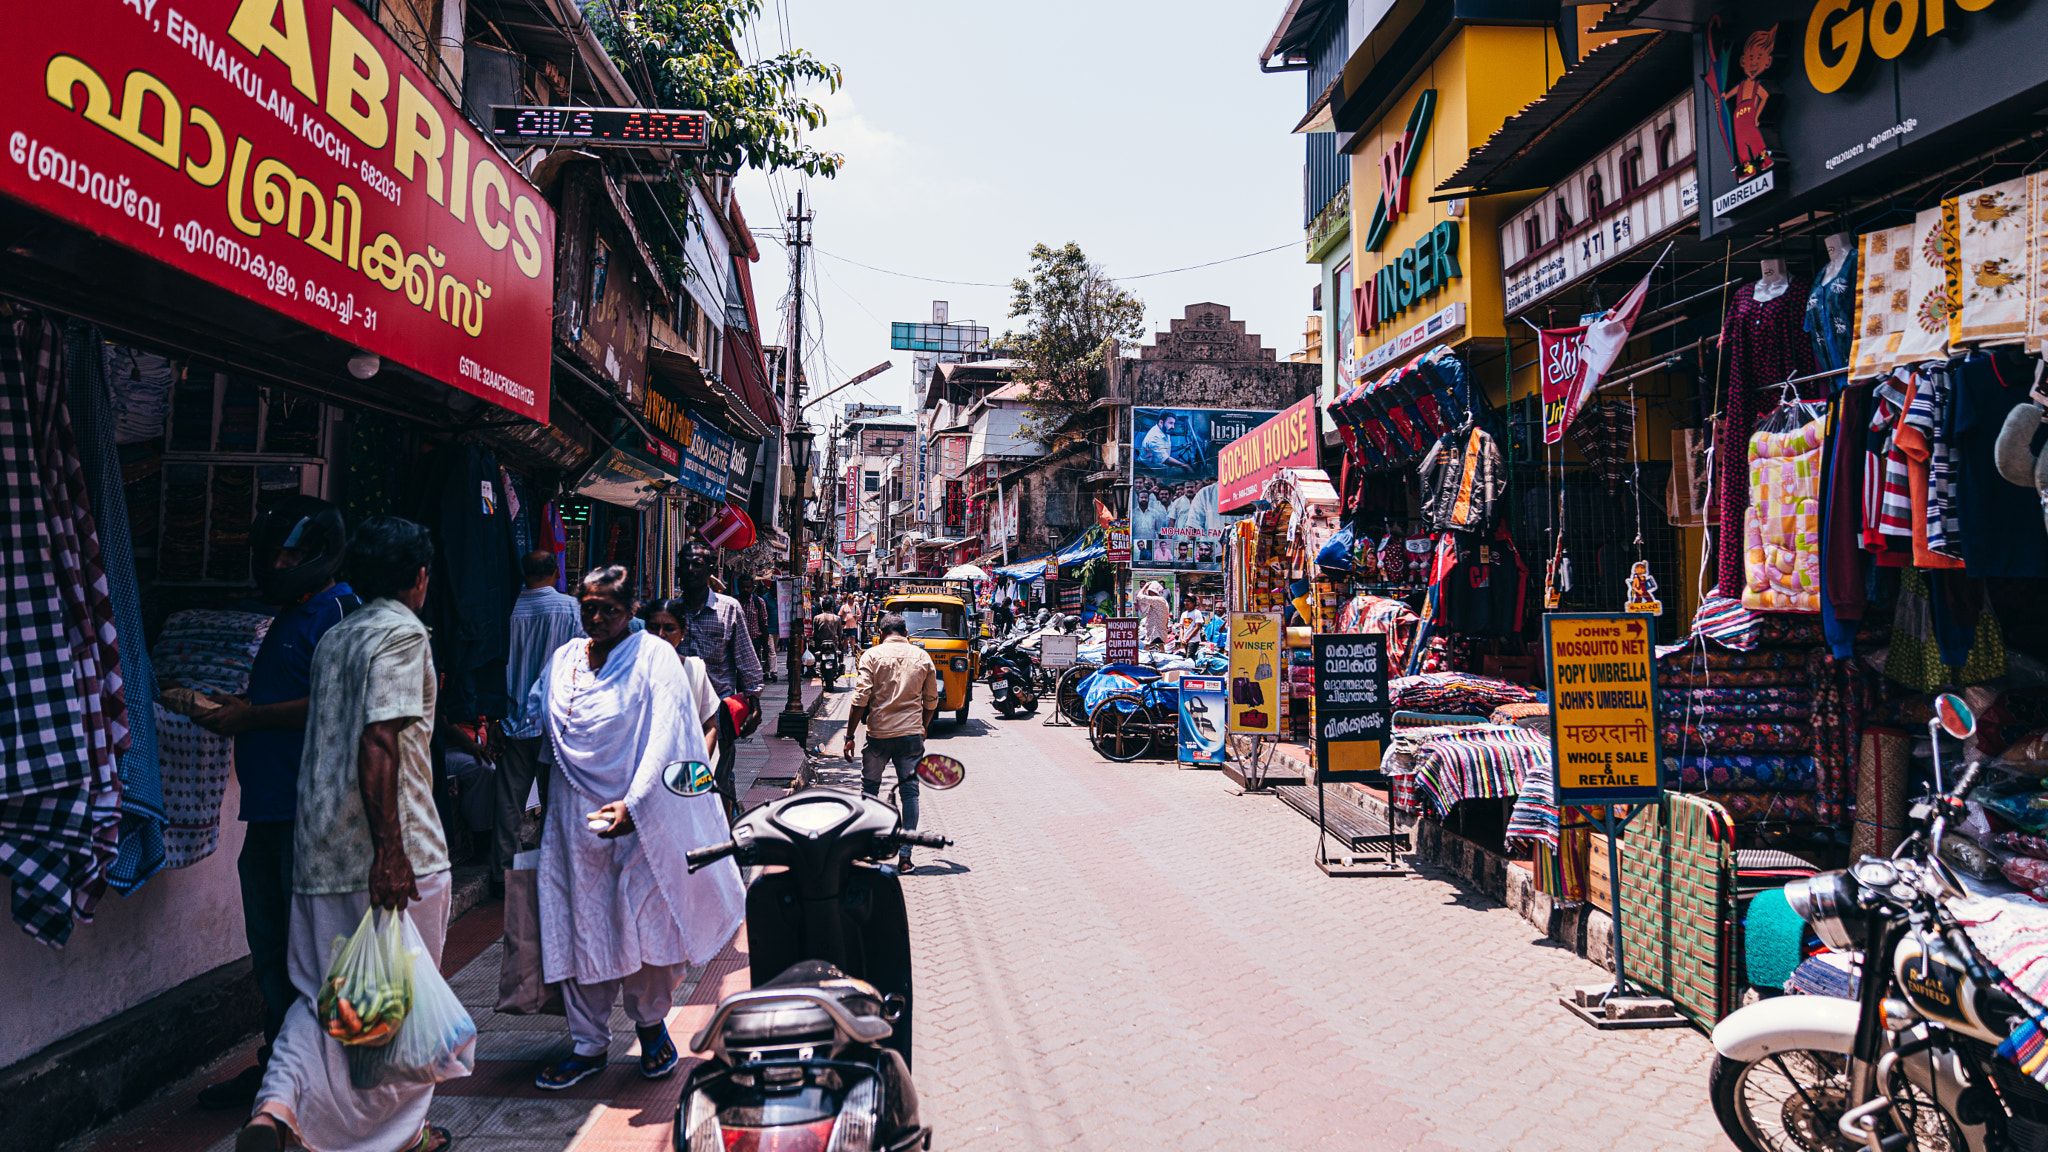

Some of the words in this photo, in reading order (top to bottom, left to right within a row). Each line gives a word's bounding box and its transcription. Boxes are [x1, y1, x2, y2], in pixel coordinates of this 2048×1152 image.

[166, 8, 298, 135] ERNAKULAM,
[301, 113, 350, 168] KOCHI
[360, 159, 401, 206] 682031
[1715, 177, 1769, 212] UMBRELLA
[174, 220, 298, 300] എറണാകുളം,
[1352, 220, 1463, 336] WINSER
[1508, 286, 1533, 310] BROADWAY
[1535, 267, 1566, 295] ERNAKULAM
[459, 355, 482, 382] GSTIN:
[1222, 434, 1261, 487] COCHIN
[1263, 407, 1309, 468] HOUSE
[1111, 532, 1130, 540] MEGA
[1161, 527, 1206, 537] MOHANLAL
[1112, 540, 1130, 550] SALE
[1108, 621, 1137, 630] MOSQUITO
[1575, 627, 1621, 637] JOHN'S
[1110, 631, 1133, 639] NETS
[1108, 639, 1137, 648] CURTAIN
[1234, 641, 1273, 651] WINSER
[1556, 640, 1619, 657] MOSQUITO
[1622, 640, 1645, 655] NET
[1109, 649, 1133, 657] CLOTH
[1558, 664, 1587, 684] POPY
[1589, 662, 1647, 683] UMBRELLA
[1559, 691, 1594, 710] JOHN'S
[1597, 690, 1648, 709] UMBRELLA
[1563, 718, 1648, 744] मछरदानी
[1567, 752, 1612, 763] WHOLE
[1616, 752, 1648, 763] SALE
[1604, 763, 1613, 774] &
[1579, 775, 1639, 786] RETAILE
[1907, 980, 1951, 1006] ENFIELD
